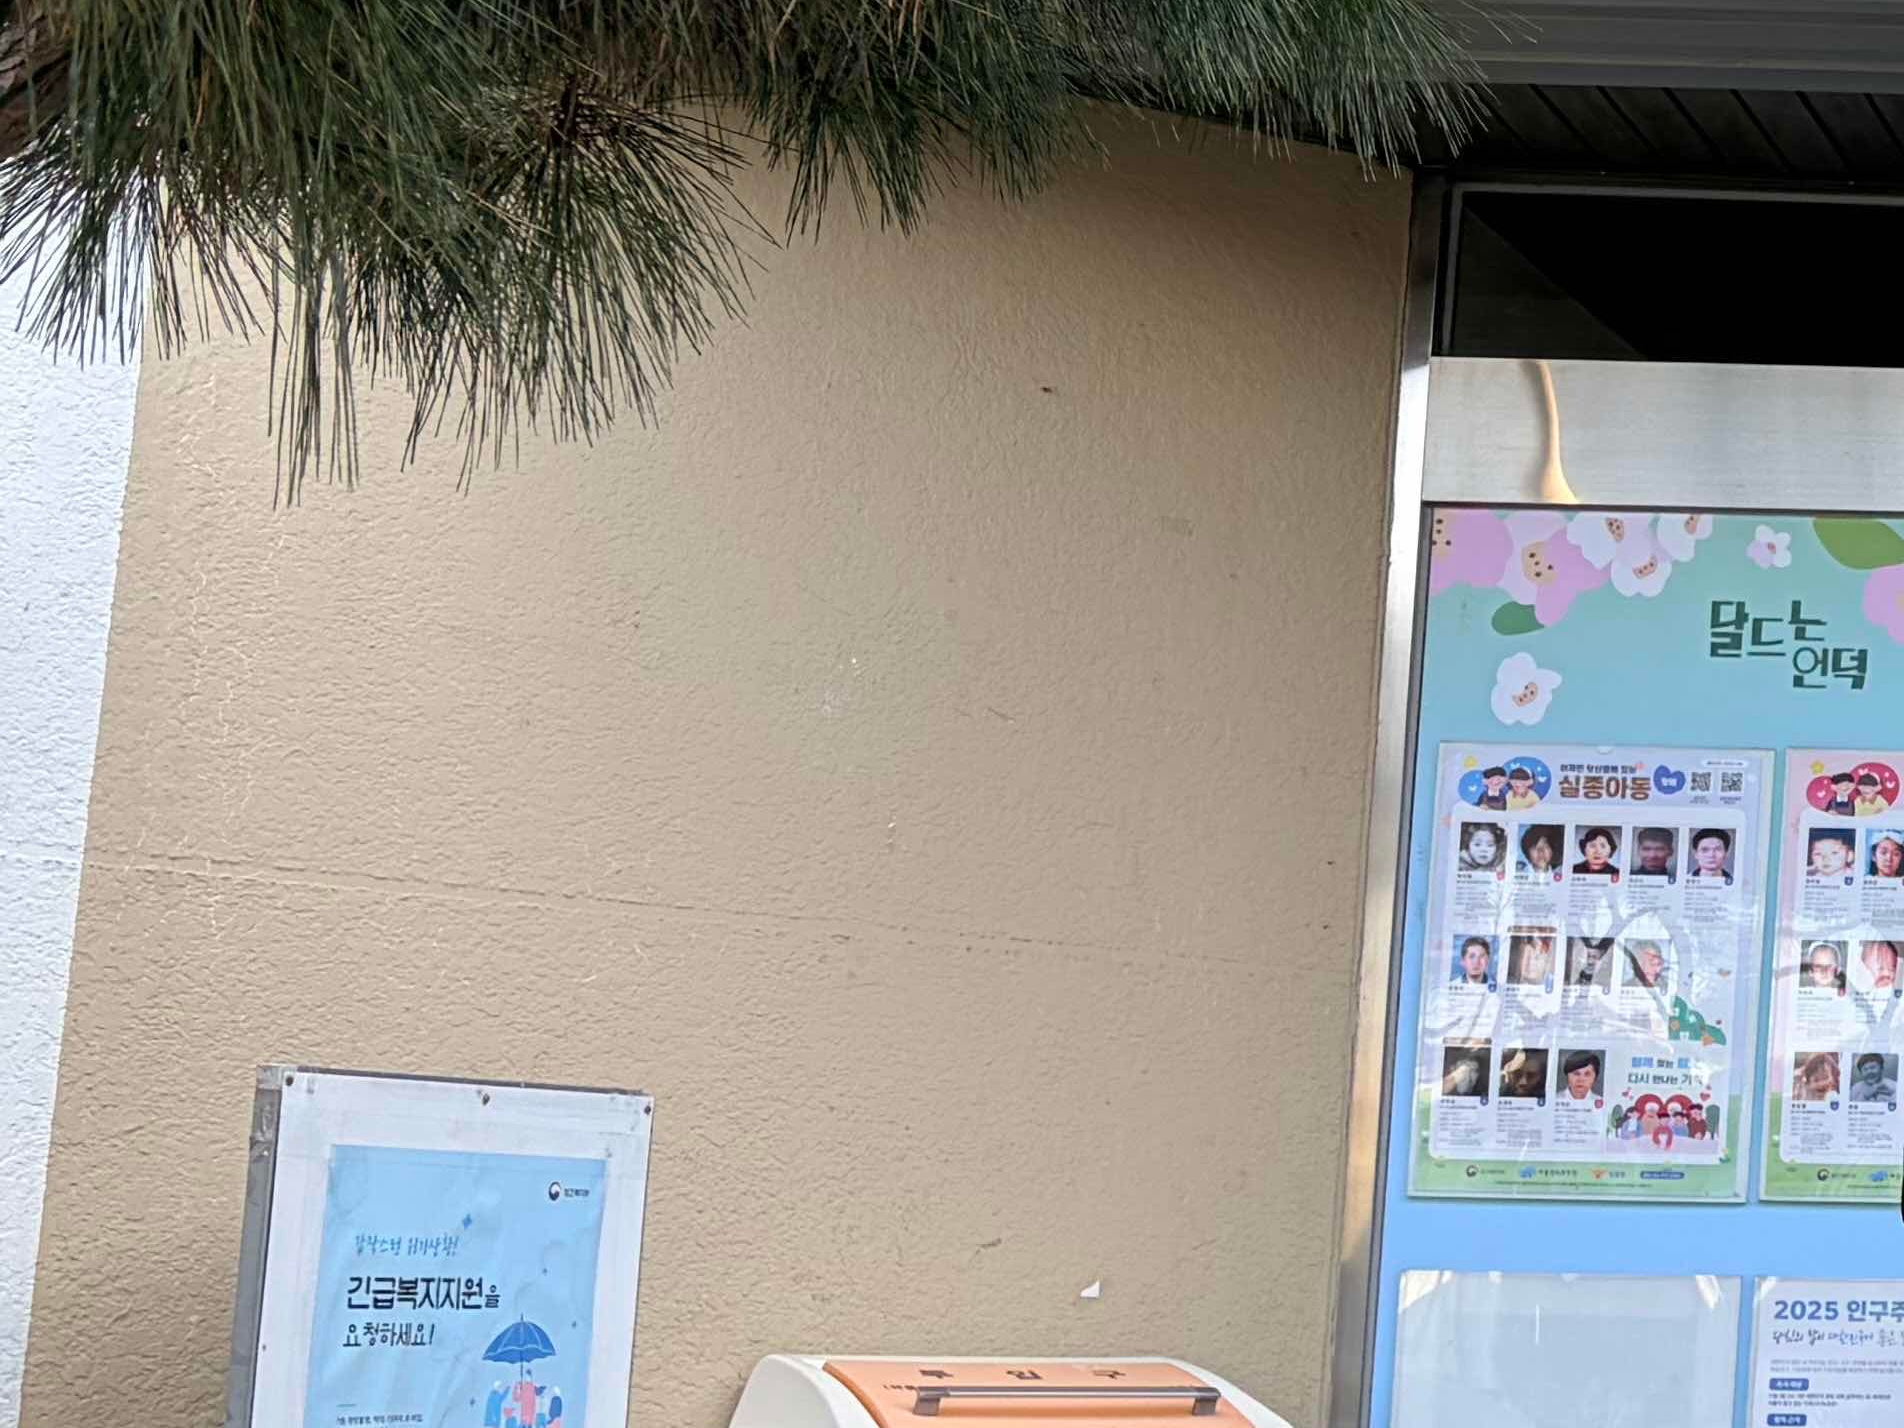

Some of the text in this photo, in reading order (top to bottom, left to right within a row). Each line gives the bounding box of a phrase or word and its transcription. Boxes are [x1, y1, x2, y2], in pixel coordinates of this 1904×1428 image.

[1793, 647, 1869, 690] 언덕
[1558, 774, 1652, 801] 실종아동
[347, 1276, 501, 1311] 긴급복지지원을
[1774, 1300, 1840, 1321] 2025
[342, 1322, 435, 1347] 요청하세요!
